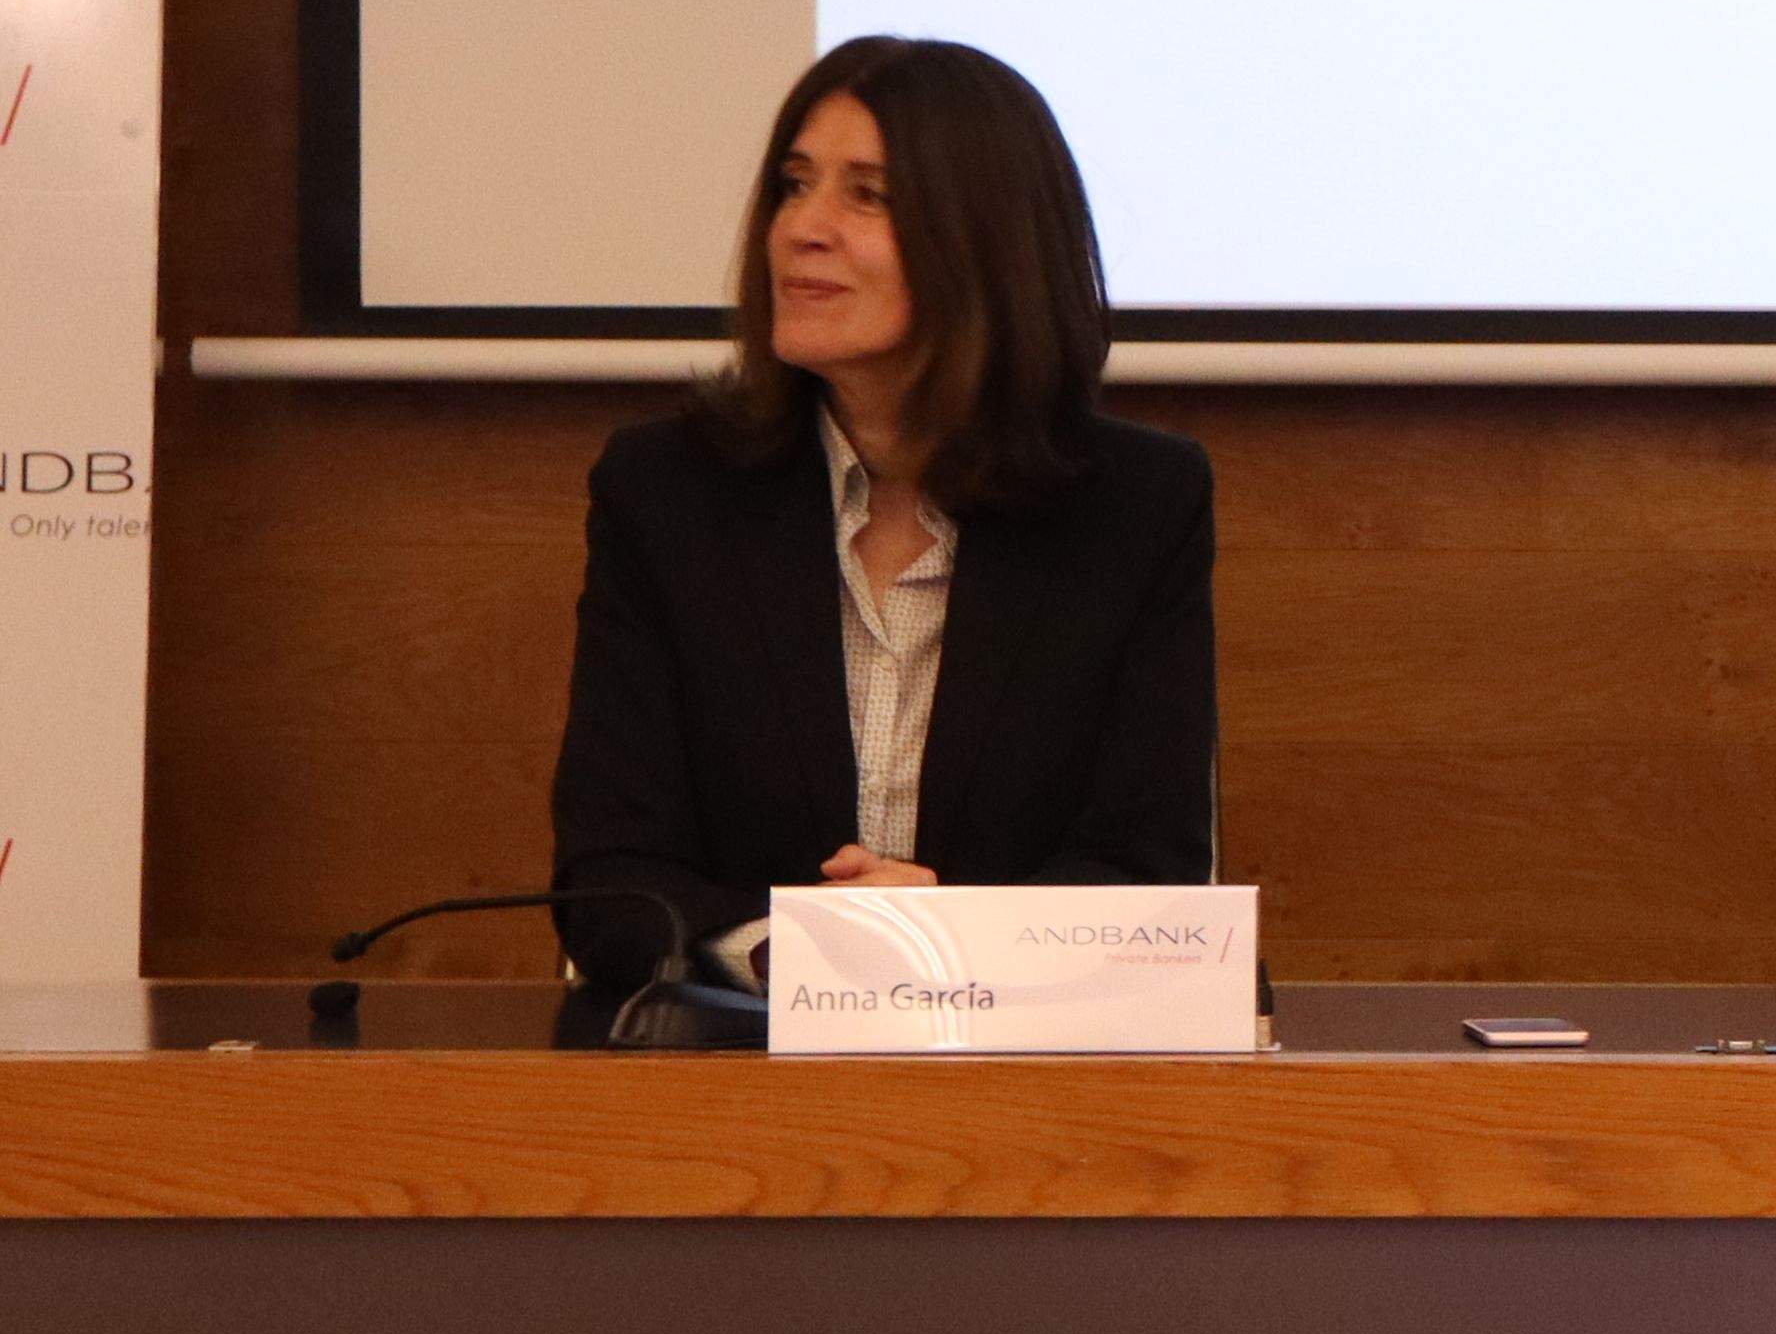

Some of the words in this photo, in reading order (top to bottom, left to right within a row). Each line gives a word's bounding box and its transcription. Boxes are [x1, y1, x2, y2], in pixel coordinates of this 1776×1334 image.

[10, 513, 76, 542] Only
[1015, 925, 1208, 946] ANDBANK
[790, 983, 878, 1011] Anna
[889, 981, 995, 1011] García
